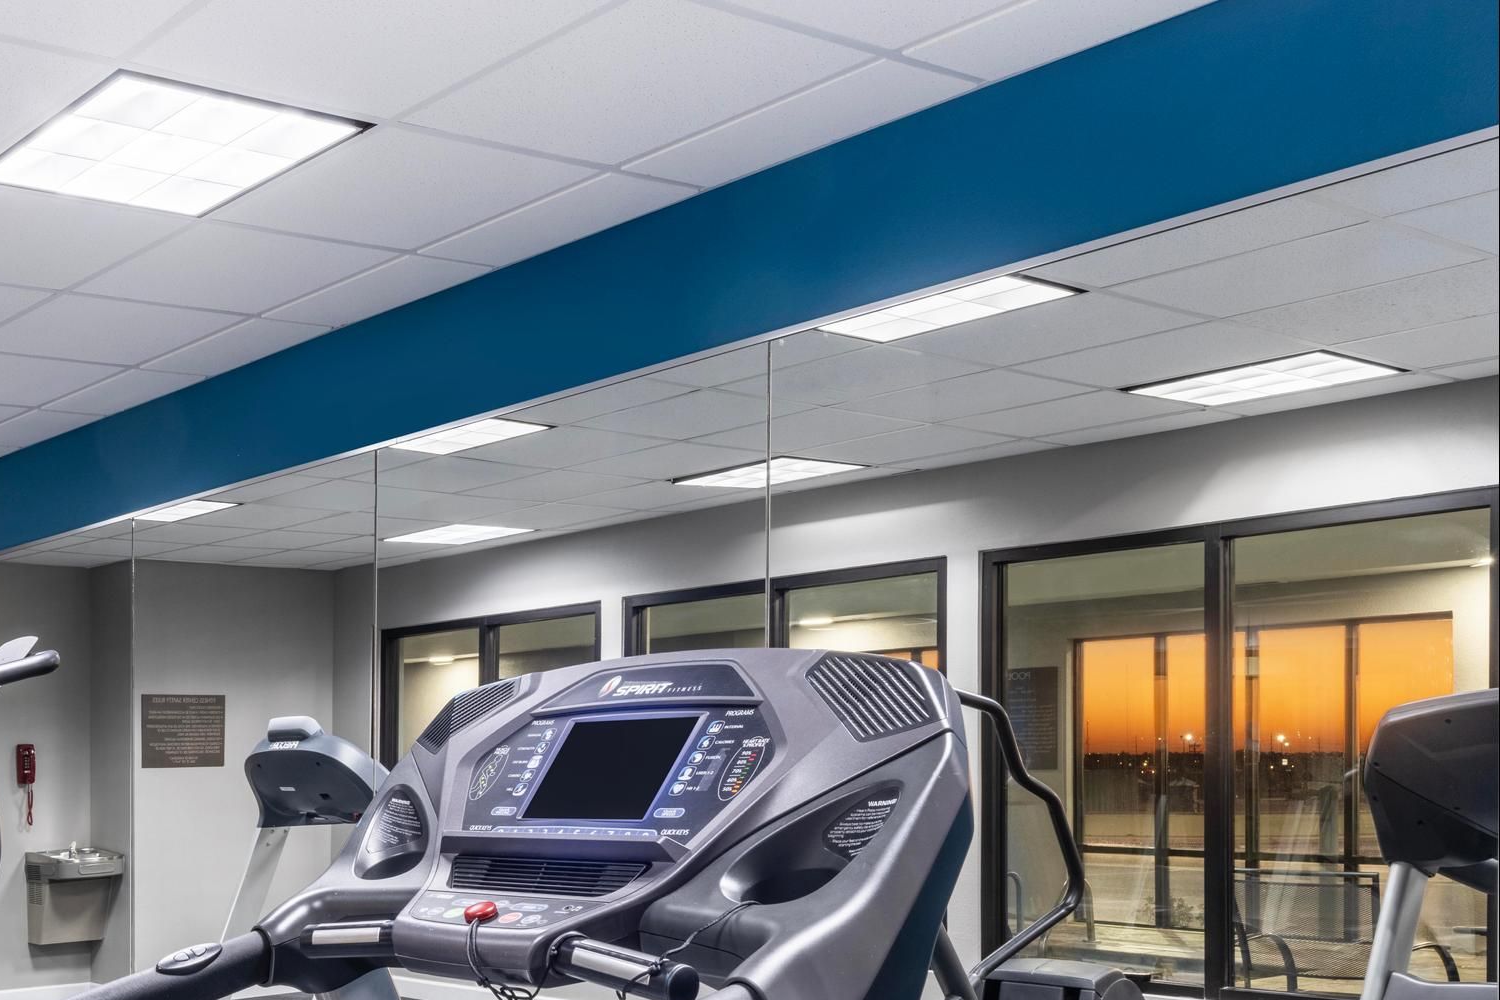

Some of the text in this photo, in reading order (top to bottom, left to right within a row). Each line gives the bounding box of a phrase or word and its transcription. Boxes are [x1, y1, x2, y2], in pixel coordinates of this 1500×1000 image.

[612, 682, 702, 697] SPIRIT FITNESS
[868, 798, 897, 807] WARNING
